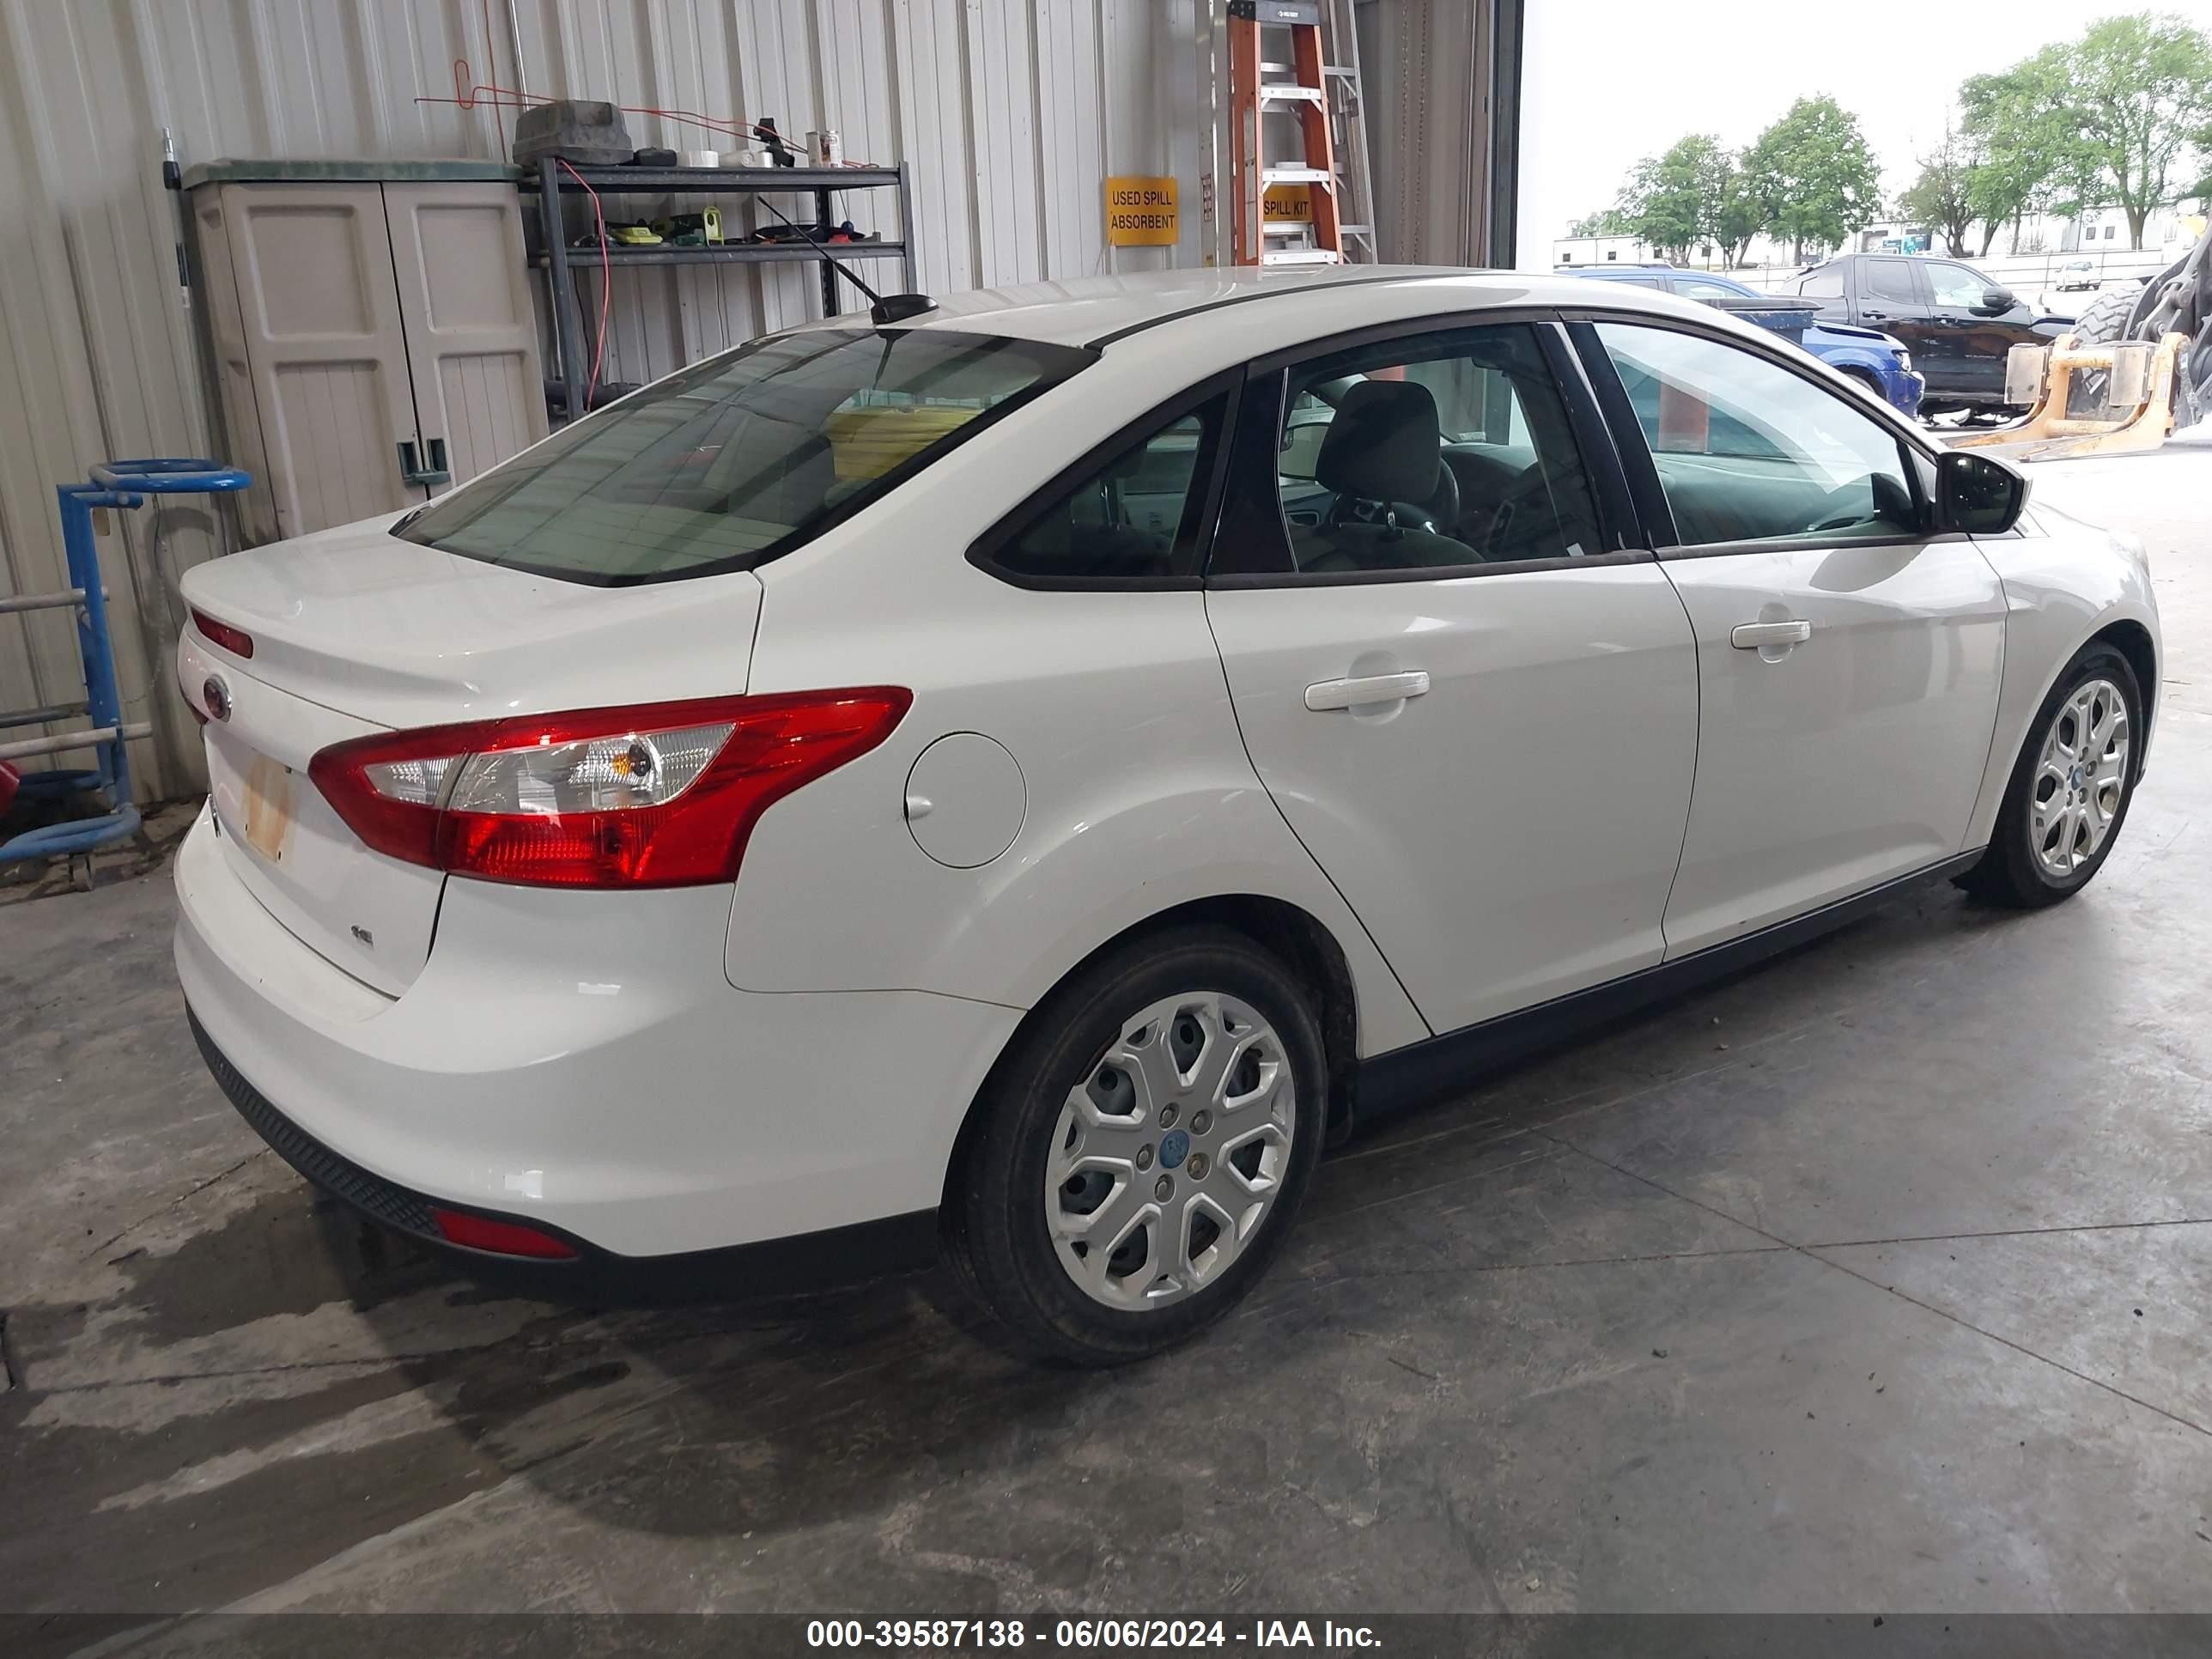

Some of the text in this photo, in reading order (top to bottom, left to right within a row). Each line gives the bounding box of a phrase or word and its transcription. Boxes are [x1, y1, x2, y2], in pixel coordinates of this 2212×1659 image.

[1112, 191, 1172, 205] USED SPILL
[1263, 199, 1310, 216] SPILL KIT
[1111, 214, 1175, 229] ABSORBENT
